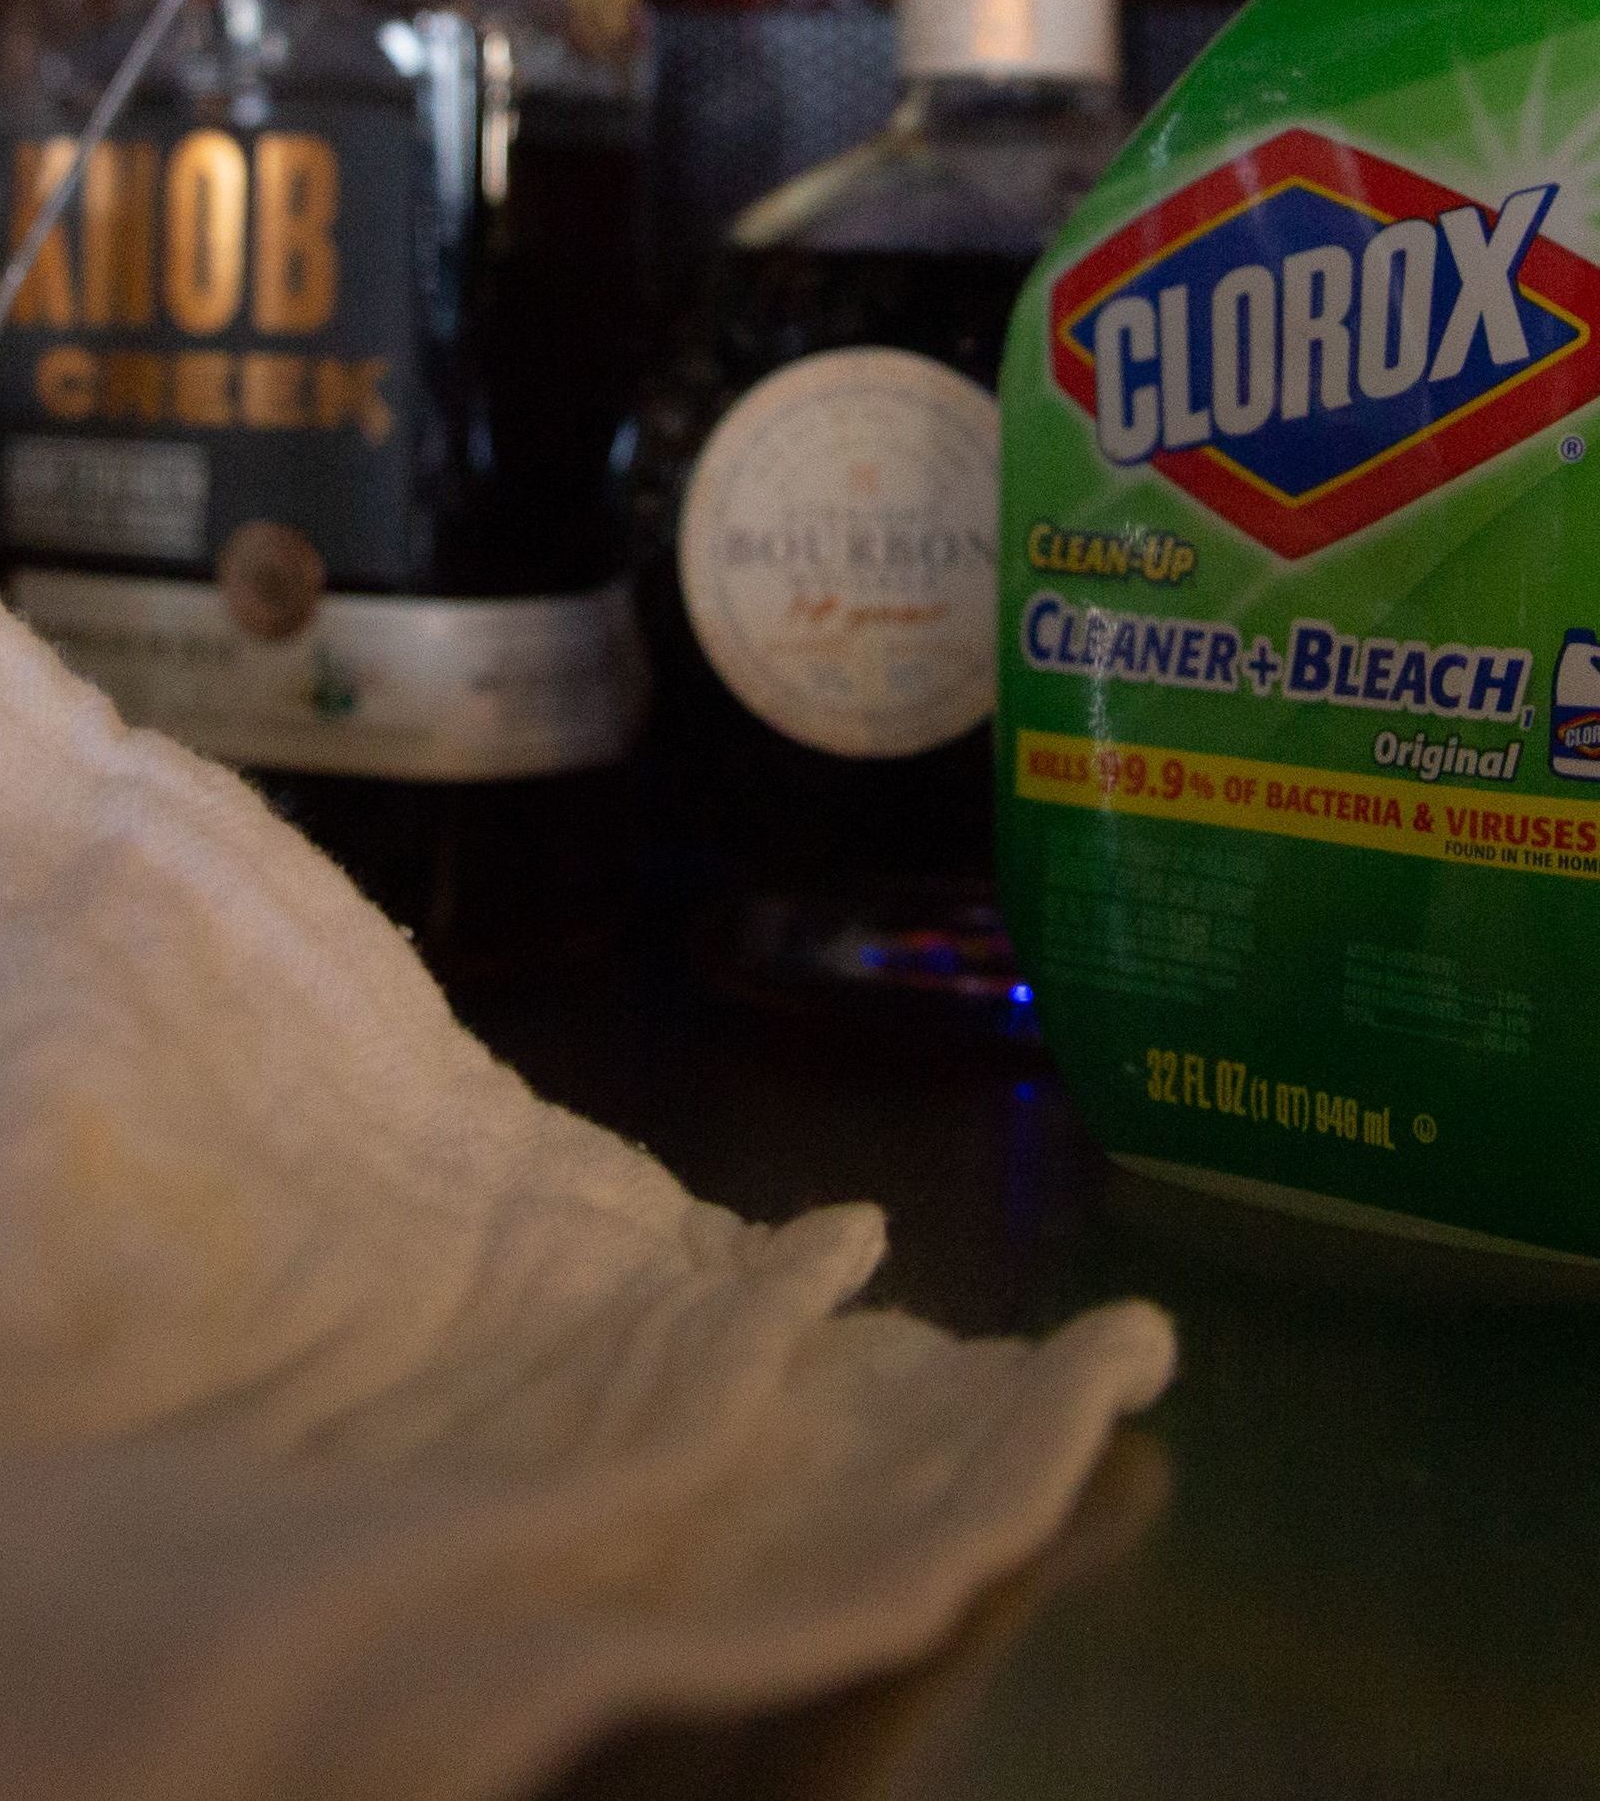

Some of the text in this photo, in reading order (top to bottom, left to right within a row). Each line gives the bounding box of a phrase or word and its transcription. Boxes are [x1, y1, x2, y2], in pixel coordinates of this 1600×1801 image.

[1095, 182, 1561, 466] CLOROX
[1027, 750, 1091, 784] KILLS
[1222, 775, 1259, 807] OF
[1265, 780, 1403, 831] BACTERIA
[1412, 800, 1436, 834] &
[1373, 729, 1522, 781] Original
[1444, 839, 1496, 861] FOUND
[1500, 848, 1520, 865] IN
[1523, 851, 1553, 870] THE
[1146, 1046, 1179, 1105] 32
[1183, 1052, 1212, 1110] FL
[1215, 1058, 1248, 1117] OZ
[1362, 1105, 1397, 1151] mL
